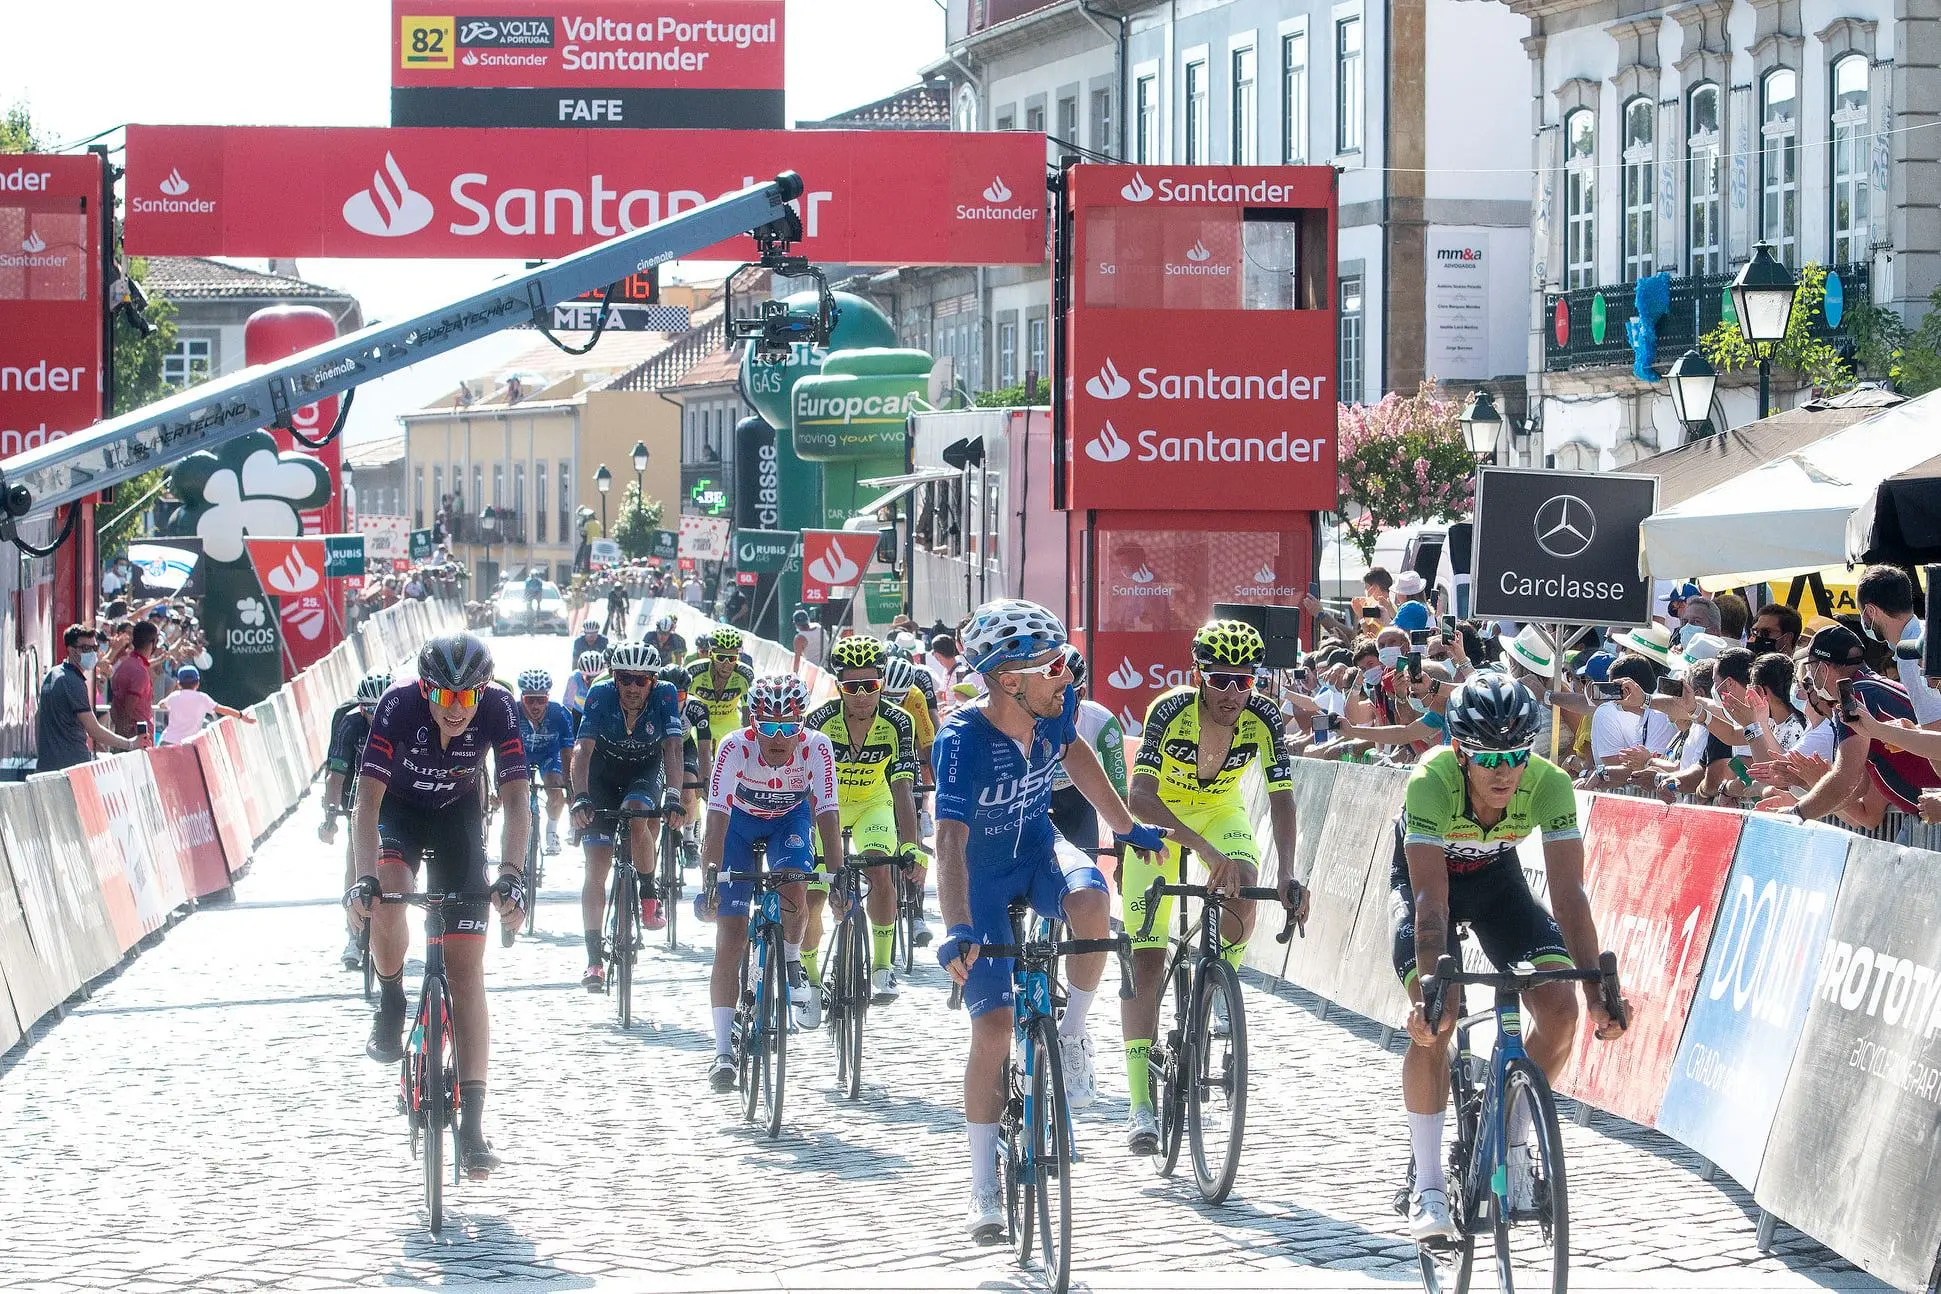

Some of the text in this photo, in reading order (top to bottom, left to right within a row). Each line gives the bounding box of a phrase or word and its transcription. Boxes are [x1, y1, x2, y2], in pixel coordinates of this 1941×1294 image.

[499, 22, 550, 36] VOLTA
[562, 17, 776, 48] Volta a Portugal
[480, 54, 548, 66] Santander
[562, 47, 709, 72] Santander
[559, 99, 623, 121] FAFE
[1158, 178, 1293, 202] Santander
[133, 198, 216, 214] Santander
[449, 173, 833, 238] Santar
[956, 204, 1038, 220] Santander
[1437, 248, 1482, 260] mm&a
[1165, 264, 1232, 275] Santander
[553, 307, 627, 330] META
[1, 360, 86, 392] nder
[752, 369, 782, 393] GÁS
[1137, 368, 1326, 400] Santander
[797, 392, 909, 424] Europcar
[840, 433, 877, 446] your
[1137, 430, 1326, 462] Santander
[332, 549, 362, 559] RUBIS
[756, 544, 786, 555] RUBIS
[806, 589, 824, 600] 25.
[1112, 585, 1175, 597] Santander
[1235, 585, 1296, 596] Santander
[1500, 571, 1624, 600] Carclasse
[302, 597, 321, 608] 25.
[225, 627, 274, 649] JOGOS
[809, 704, 836, 729] EFAPEL
[1157, 692, 1189, 721] EFAPEL
[1250, 696, 1283, 730] EFAPEL
[884, 707, 910, 732] EFAPEL
[948, 733, 961, 784] BOLFLEX
[412, 780, 457, 791] BH
[457, 919, 488, 931] BH
[1663, 904, 1701, 1021] 1
